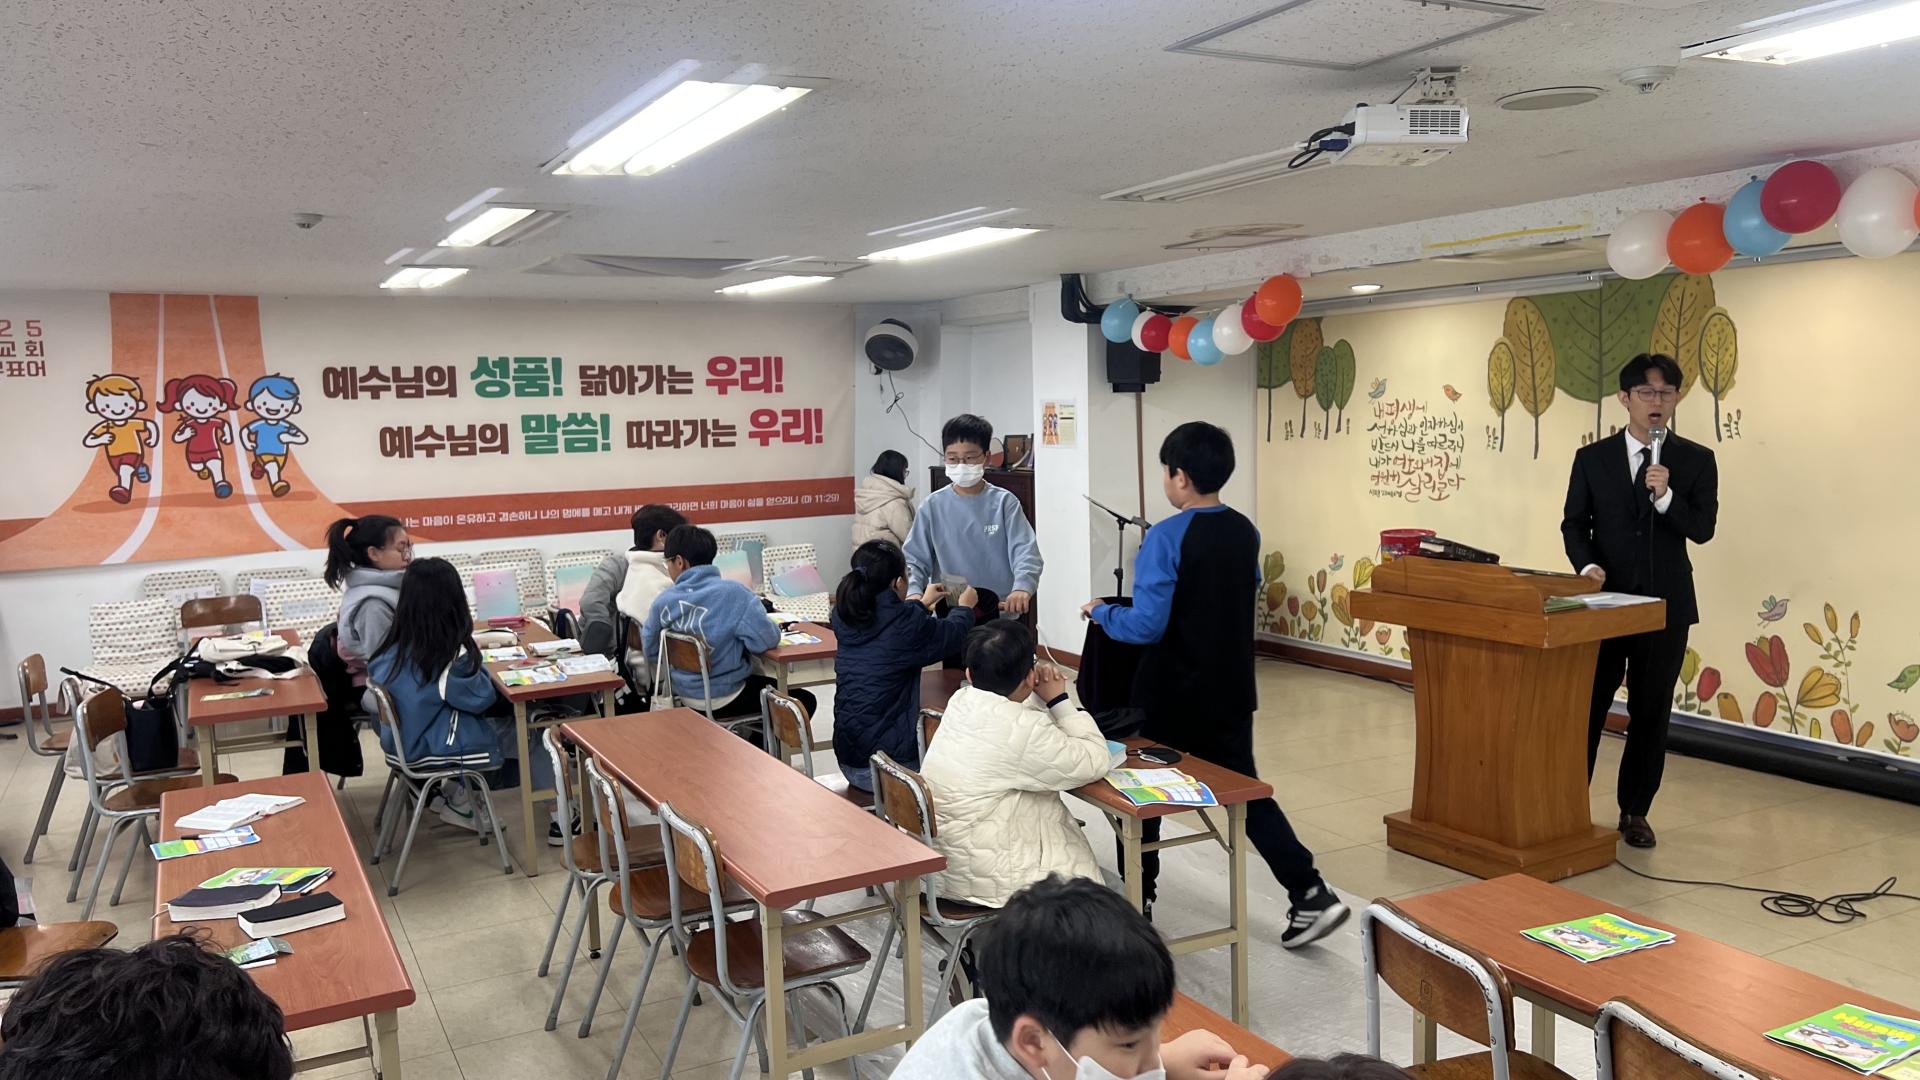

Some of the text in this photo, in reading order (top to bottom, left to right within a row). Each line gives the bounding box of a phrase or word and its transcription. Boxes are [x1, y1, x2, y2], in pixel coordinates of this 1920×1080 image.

[0, 361, 46, 377] 표어
[322, 355, 783, 400] 예수님의 성품! 닮아가는 우리!
[379, 408, 823, 458] 예수님의 말씀! 따라가는 우리!
[1367, 411, 1464, 439] 선하심과 인자하심이
[1371, 433, 1465, 454] 반드시 나를 따르리니
[1371, 469, 1466, 503] 영원히 살리로다
[701, 500, 718, 510] 너희
[720, 498, 745, 509] 마음이
[747, 497, 764, 508] 쉼을
[766, 495, 799, 506] 얻으리니
[801, 495, 812, 505] (마
[815, 493, 840, 503] 11:29)
[422, 515, 454, 527] 마음이
[456, 512, 496, 525] 온유하고
[498, 510, 538, 523] 겸손하니
[540, 508, 560, 520] 나의
[562, 507, 591, 519] 멍에를
[593, 506, 611, 517] 메고
[613, 505, 632, 516] 내게
